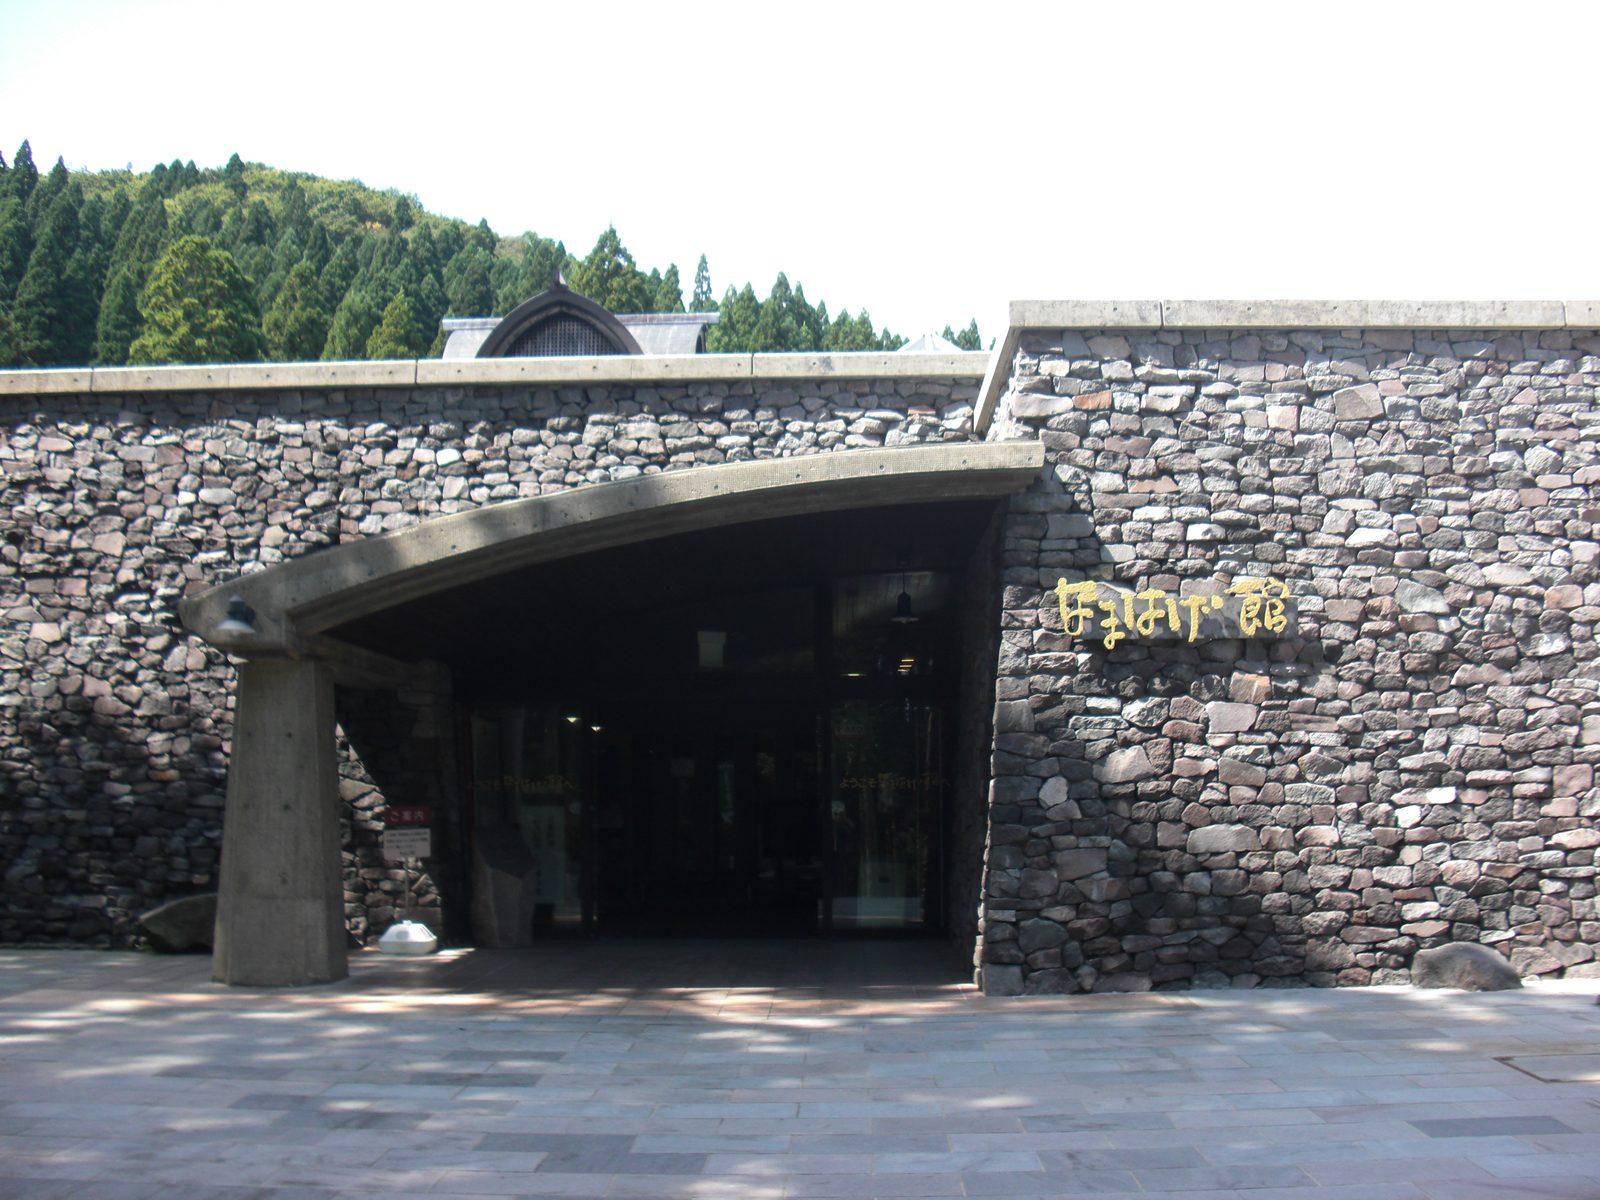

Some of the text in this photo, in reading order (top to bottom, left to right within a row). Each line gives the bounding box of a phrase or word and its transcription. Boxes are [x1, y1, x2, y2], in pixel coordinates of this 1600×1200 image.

[1054, 577, 1290, 650] なまはげ館
